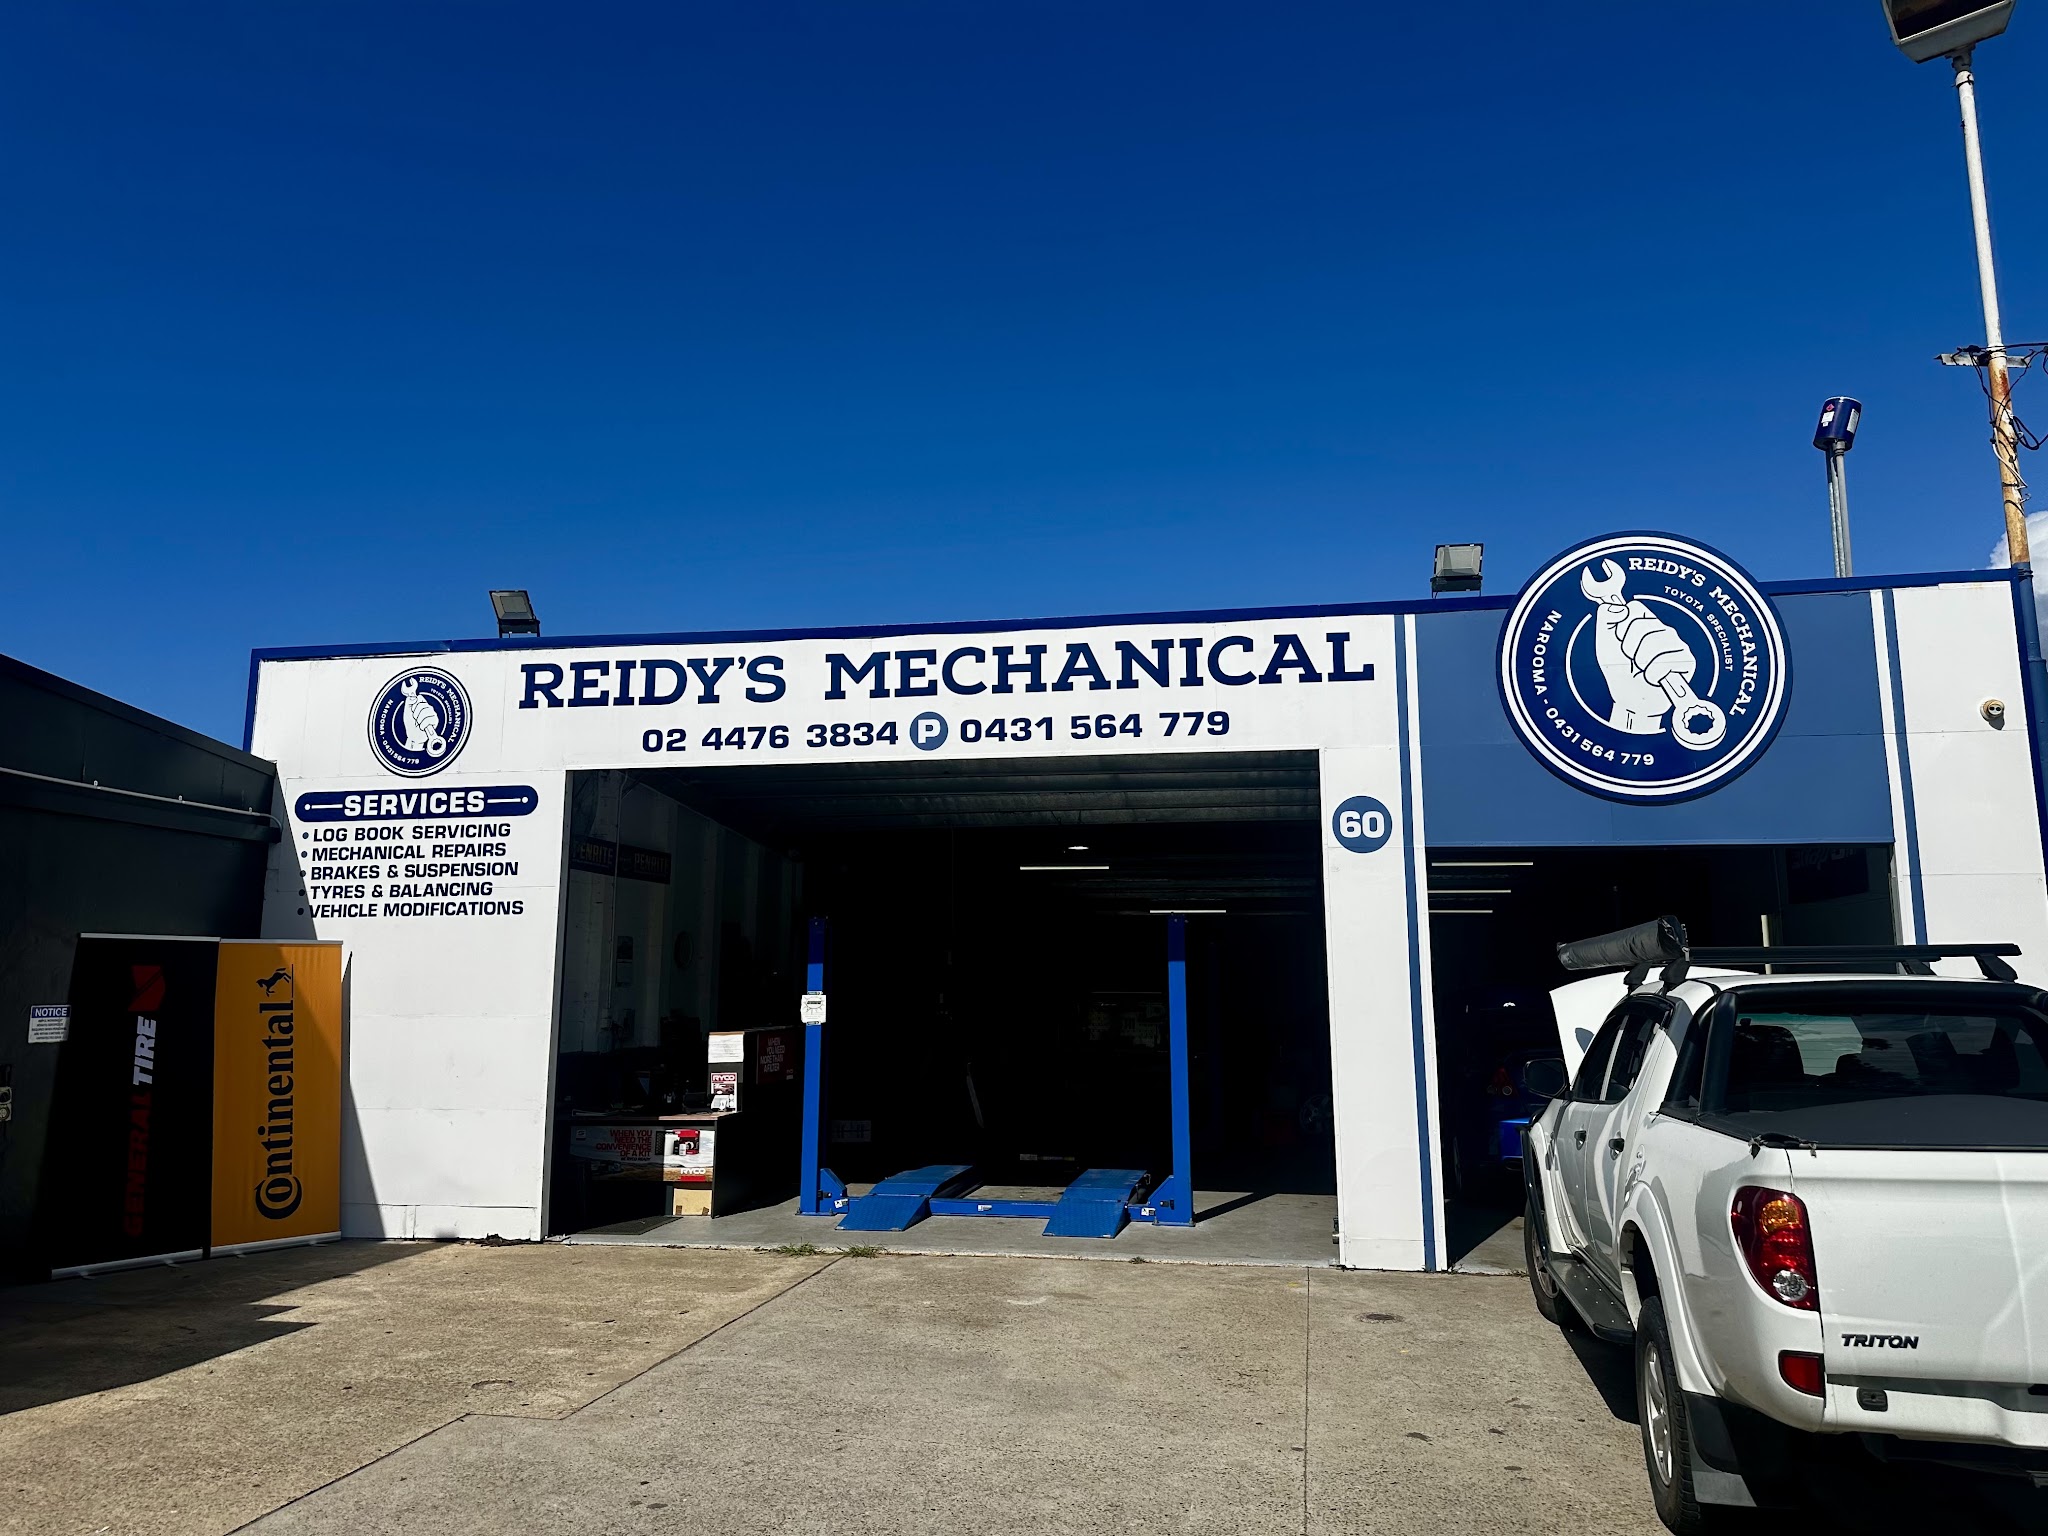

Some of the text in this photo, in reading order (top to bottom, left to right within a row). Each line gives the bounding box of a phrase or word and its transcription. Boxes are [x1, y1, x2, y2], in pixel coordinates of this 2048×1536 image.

[1628, 557, 1758, 717] REIDY'S MECHANICAL
[1664, 585, 1733, 672] TOYOTA SPECIALIST
[1532, 609, 1562, 696] NAROOMA
[518, 632, 1375, 709] REIDY'S MECHANICAL
[380, 699, 394, 736] NAROOMA
[419, 676, 462, 743] REIDY'S MECHANICAL
[643, 729, 686, 752] 02
[702, 725, 788, 751] 4476
[806, 722, 898, 747] 3834
[960, 717, 1053, 743] 0431
[1070, 714, 1142, 739] 564
[1159, 711, 1230, 737] 779
[1545, 707, 1582, 742] 0431
[382, 740, 394, 756] 0431
[1580, 738, 1615, 762] 564
[1620, 752, 1655, 766] 779
[344, 790, 485, 816] SERVICES
[313, 823, 511, 842] LOG BOOK SERVICING
[1339, 811, 1385, 839] 60
[311, 842, 507, 862] MECHANICAL REPAIRS
[310, 861, 519, 881] BRAKES & SUSPENSION
[310, 880, 493, 900] TYRES & BALANCING
[308, 900, 524, 919] VEHICLE MODIFICATIONS
[35, 1007, 68, 1017] NOTICE
[255, 999, 303, 1220] Continental
[123, 1016, 157, 1238] GENERAL TIRE
[596, 1143, 652, 1151] CONVENIENCE
[1841, 1334, 1919, 1349] TRITON
